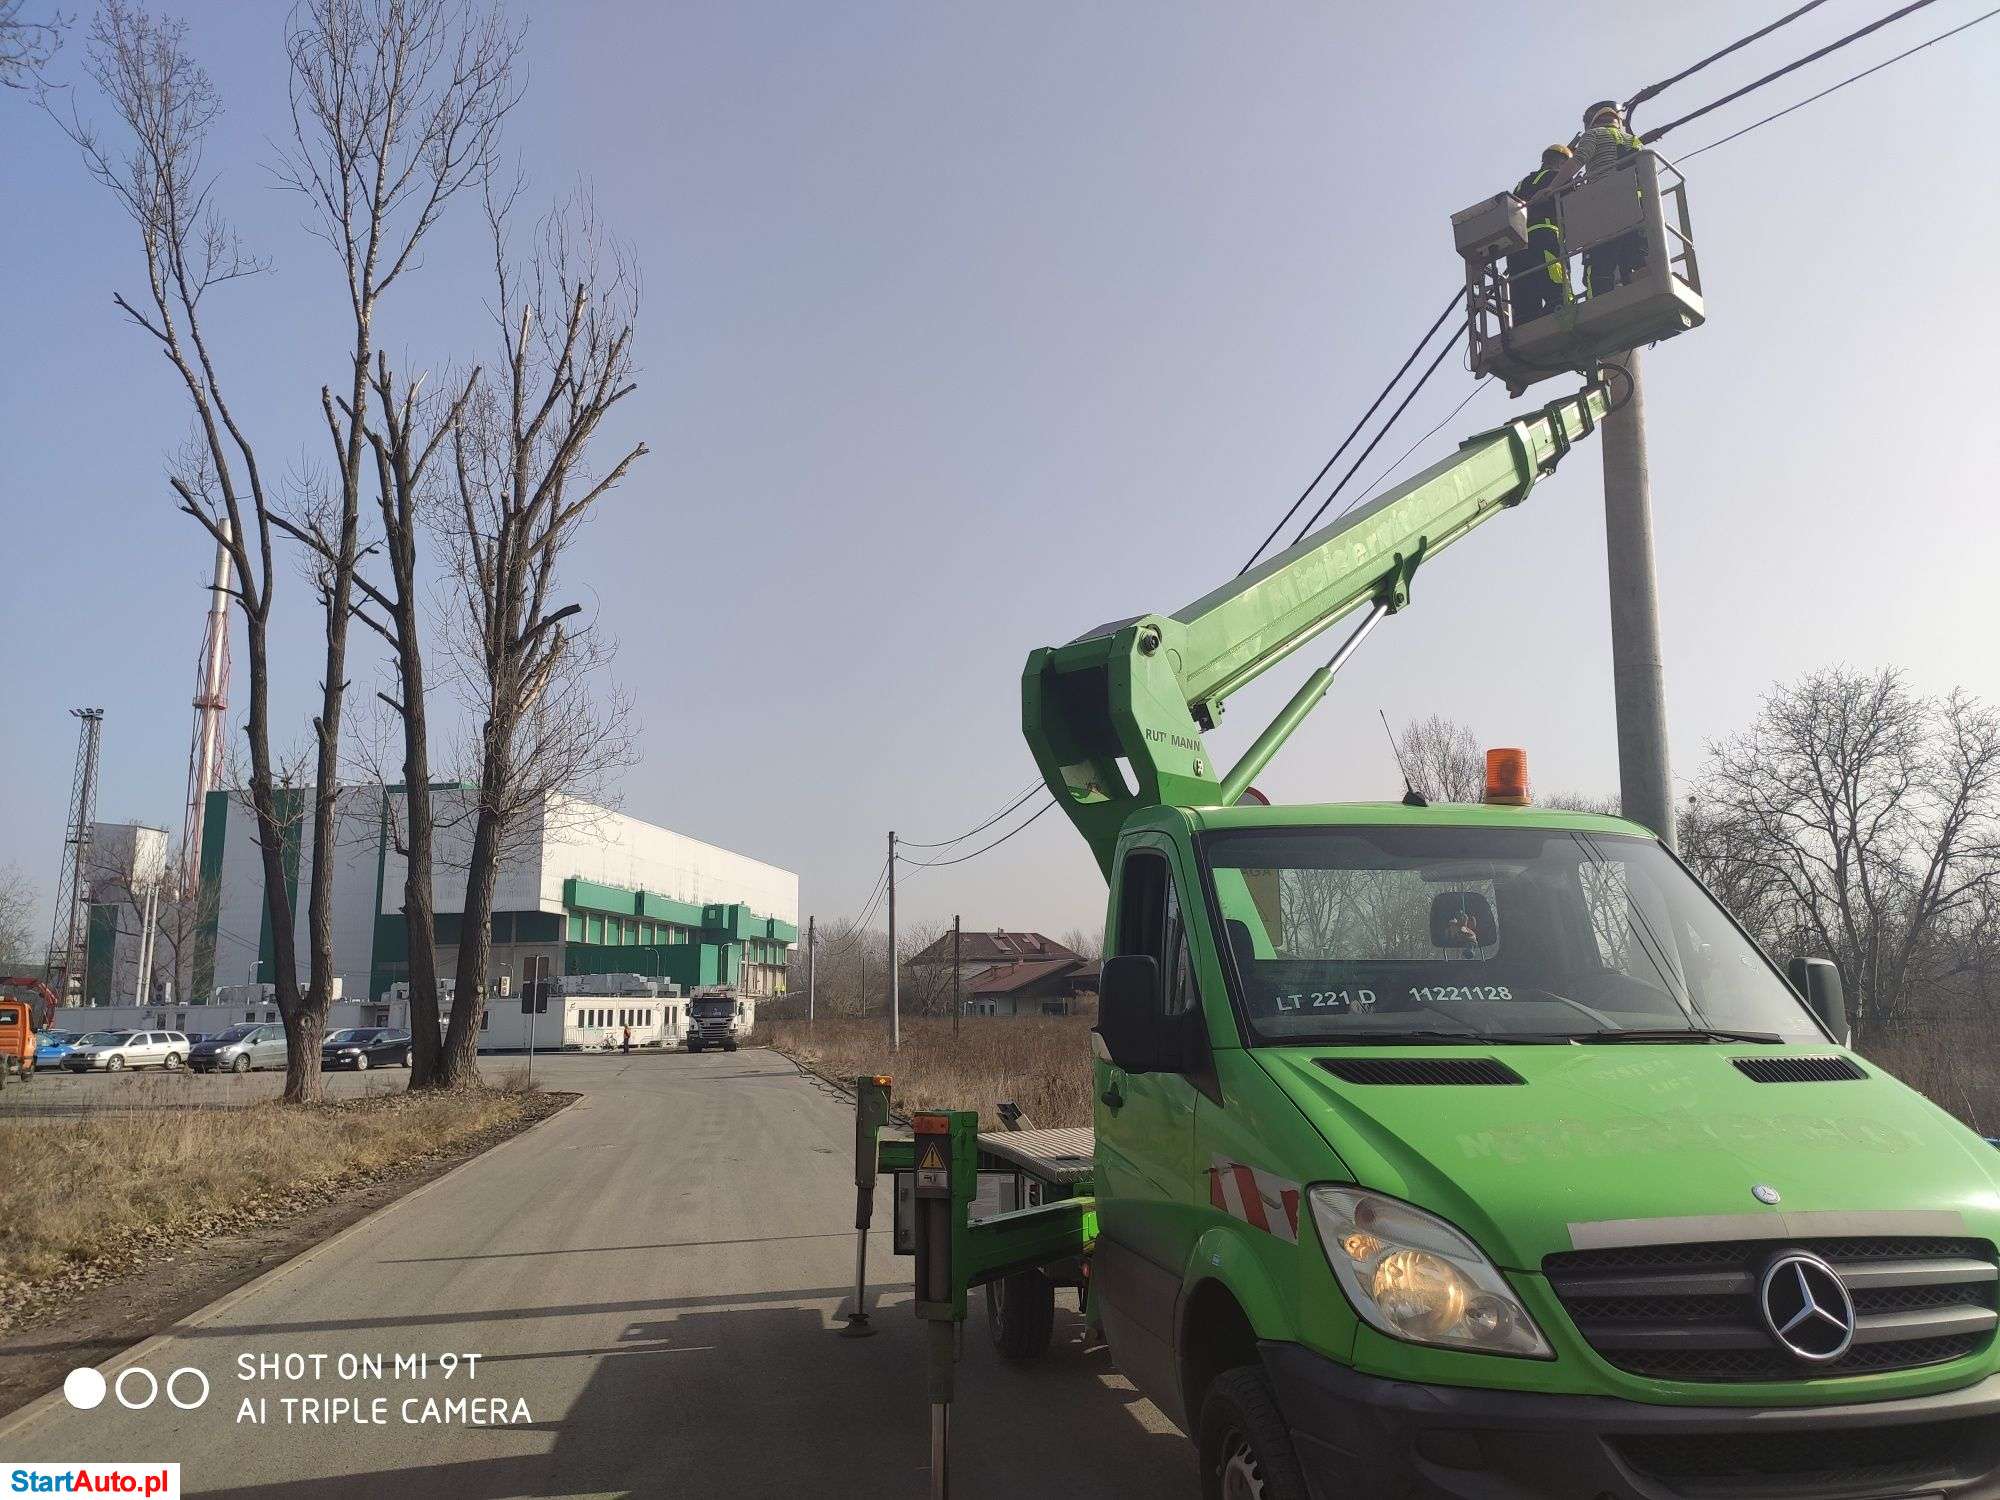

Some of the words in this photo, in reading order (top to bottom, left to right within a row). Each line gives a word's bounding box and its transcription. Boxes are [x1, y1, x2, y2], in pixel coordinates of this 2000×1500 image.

[1276, 994, 1303, 1011] LT
[1311, 990, 1350, 1007] 221
[1358, 989, 1377, 1004] D
[1409, 986, 1513, 1001] 11221128
